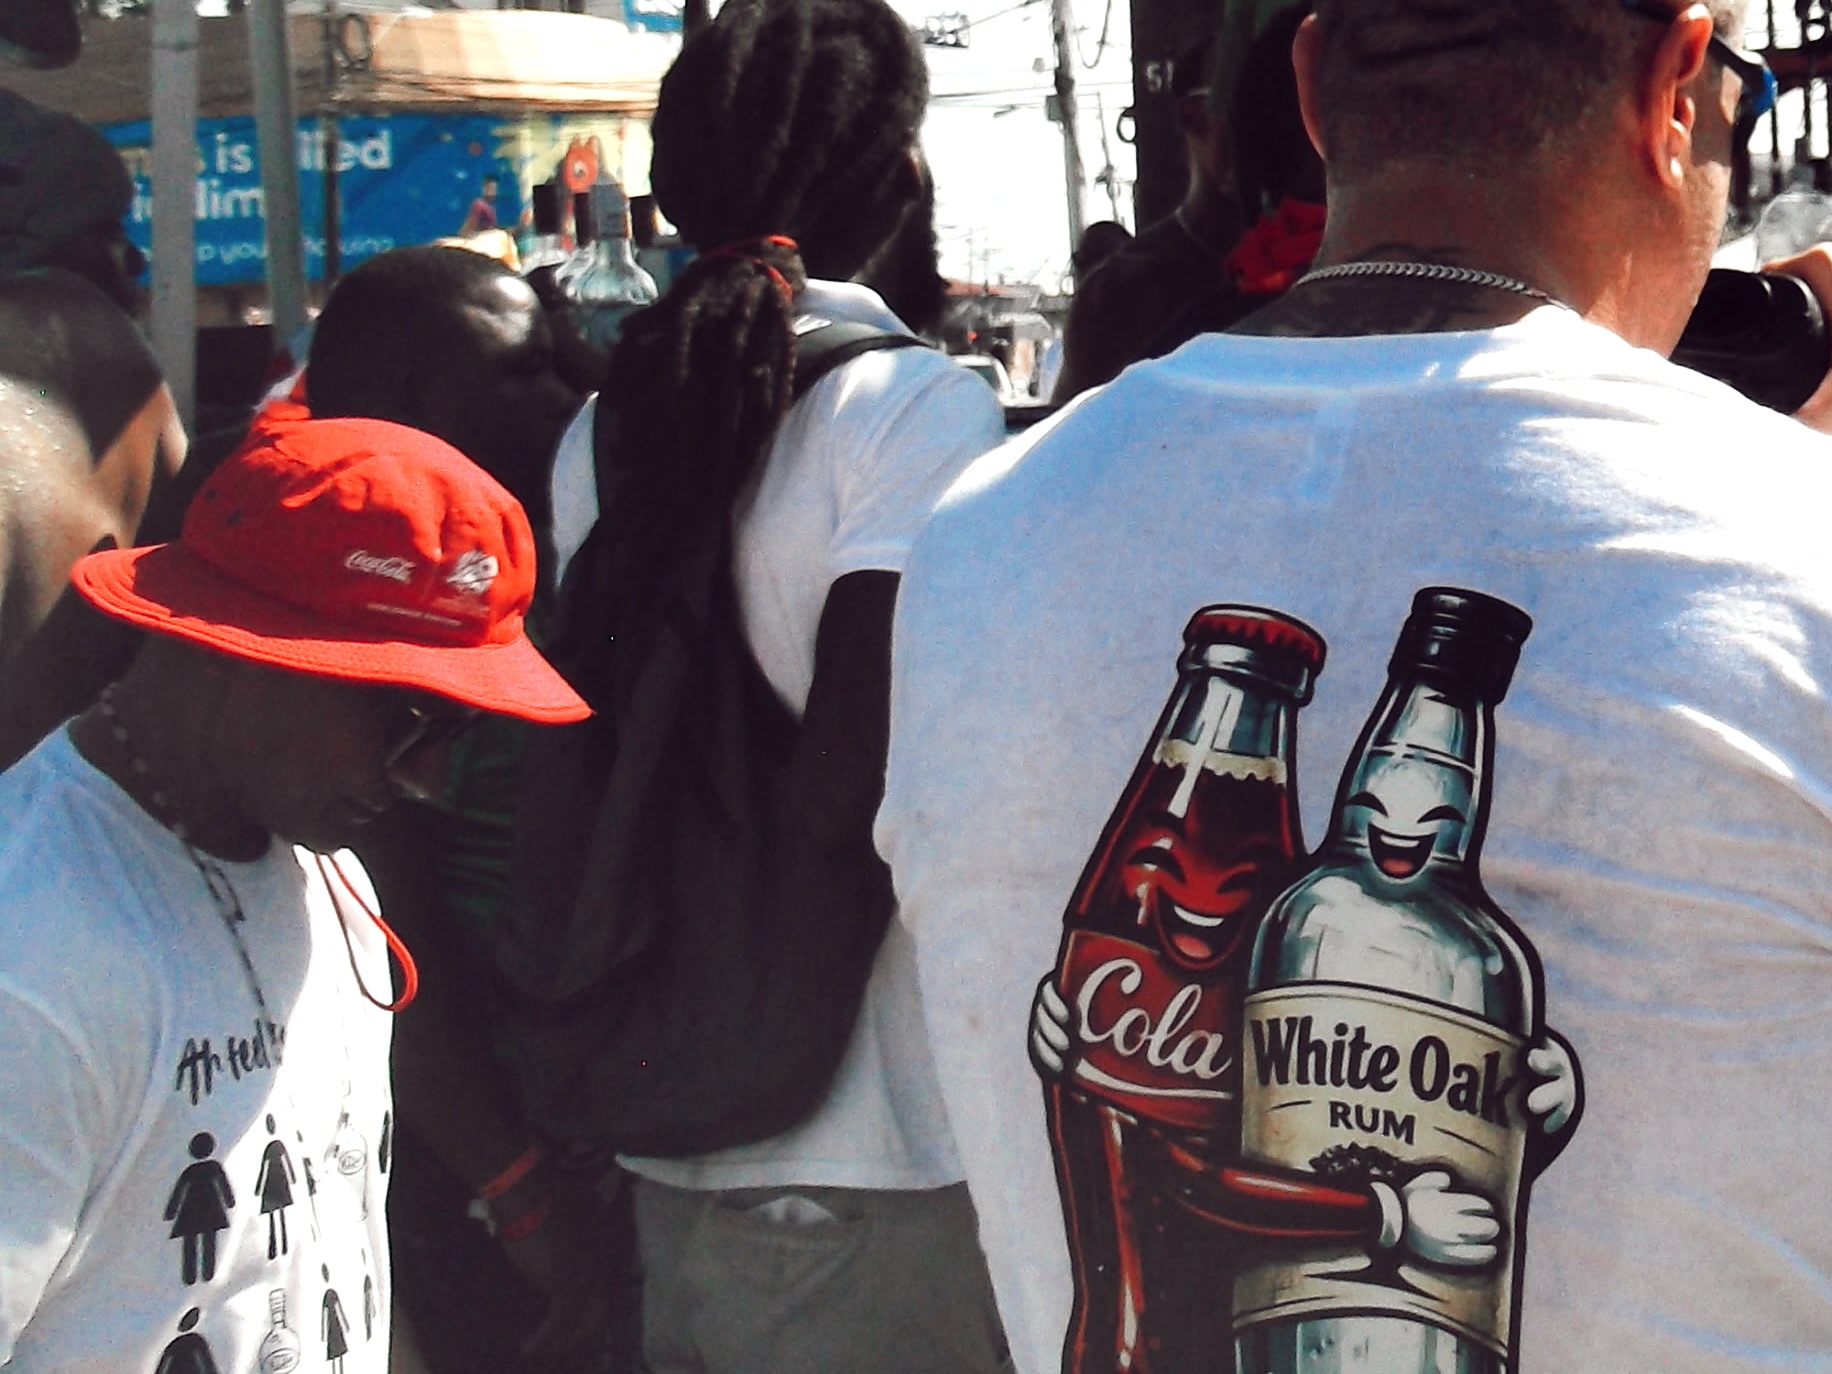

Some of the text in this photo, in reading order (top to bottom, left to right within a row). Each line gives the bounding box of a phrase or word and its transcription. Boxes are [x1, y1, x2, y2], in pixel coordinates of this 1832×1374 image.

[215, 132, 254, 174] is
[1074, 957, 1234, 1080] Cola
[1250, 1015, 1516, 1127] White Oak
[1328, 1099, 1416, 1145] RUM
